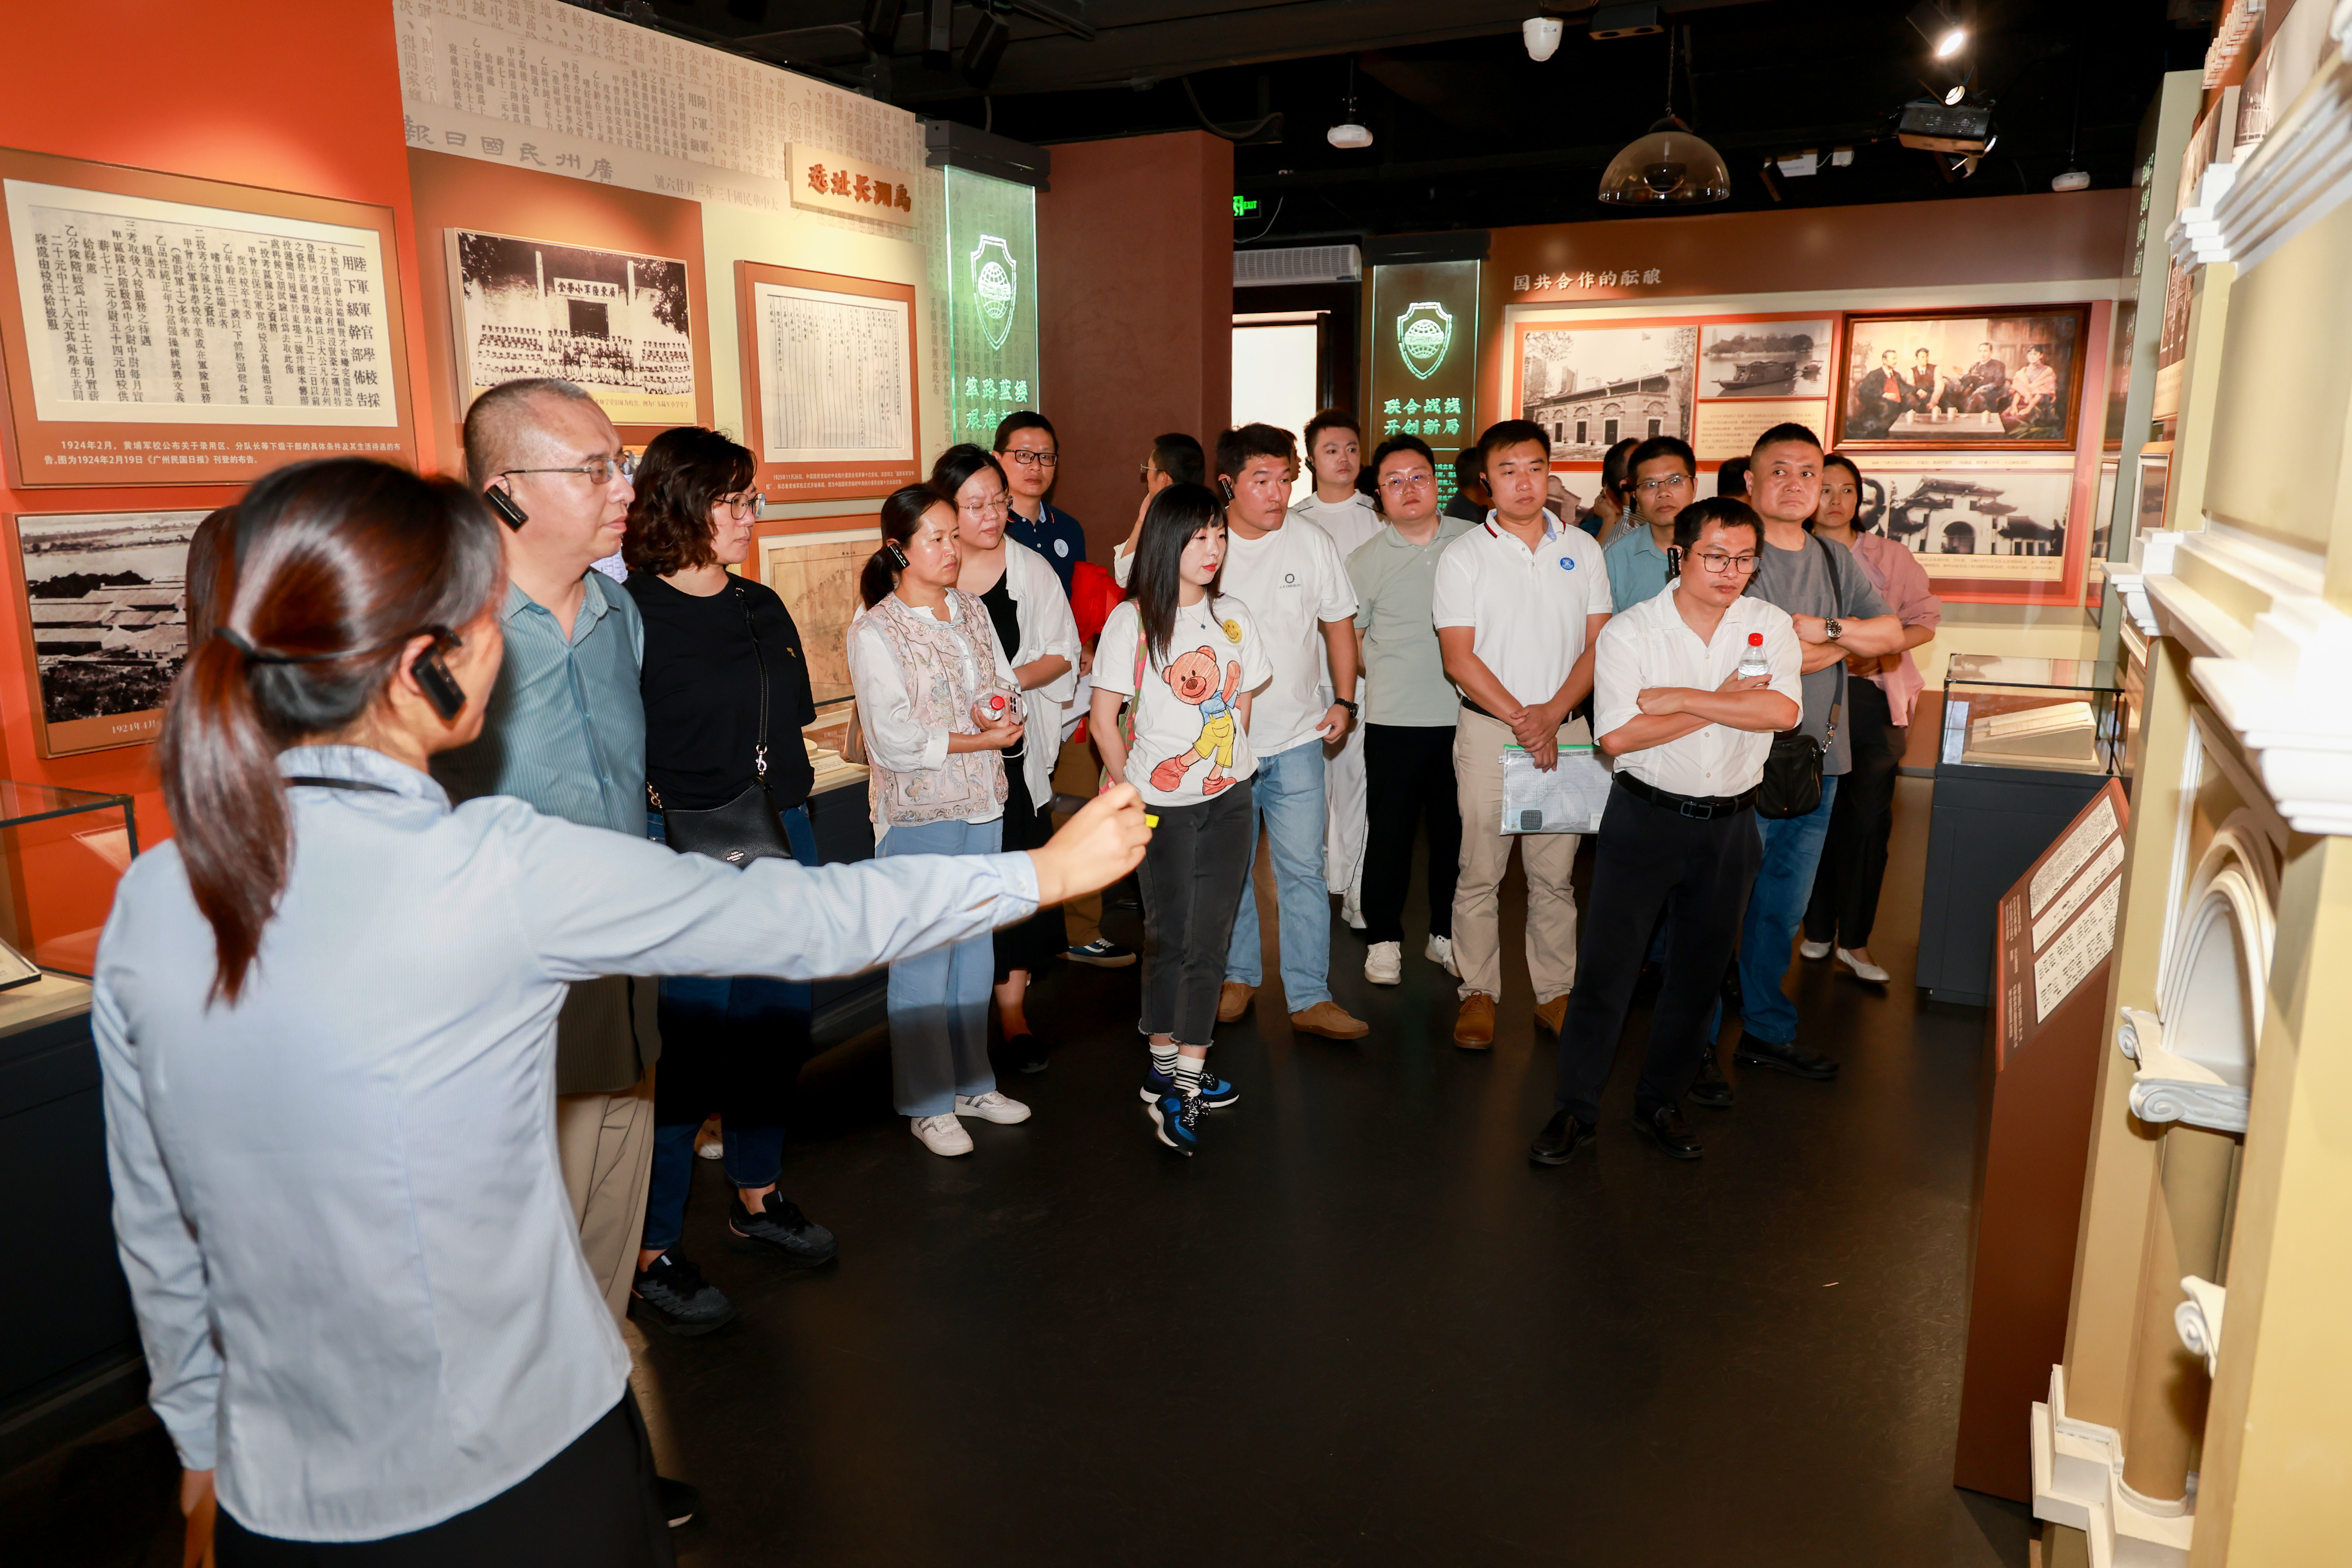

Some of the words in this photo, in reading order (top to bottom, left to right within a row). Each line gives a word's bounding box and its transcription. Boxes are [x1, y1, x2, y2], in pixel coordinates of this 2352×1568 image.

[689, 49, 699, 84] 失敗
[808, 163, 912, 212] 选址长洲岛
[1243, 200, 1257, 209] EXIT
[1513, 267, 1662, 292] 国共合作的酝酿
[352, 256, 381, 408] 陸軍軍官學校採
[965, 376, 1029, 403] 筚路蓝缕
[1383, 397, 1461, 415] 联合战线
[1383, 418, 1460, 435] 开创新局
